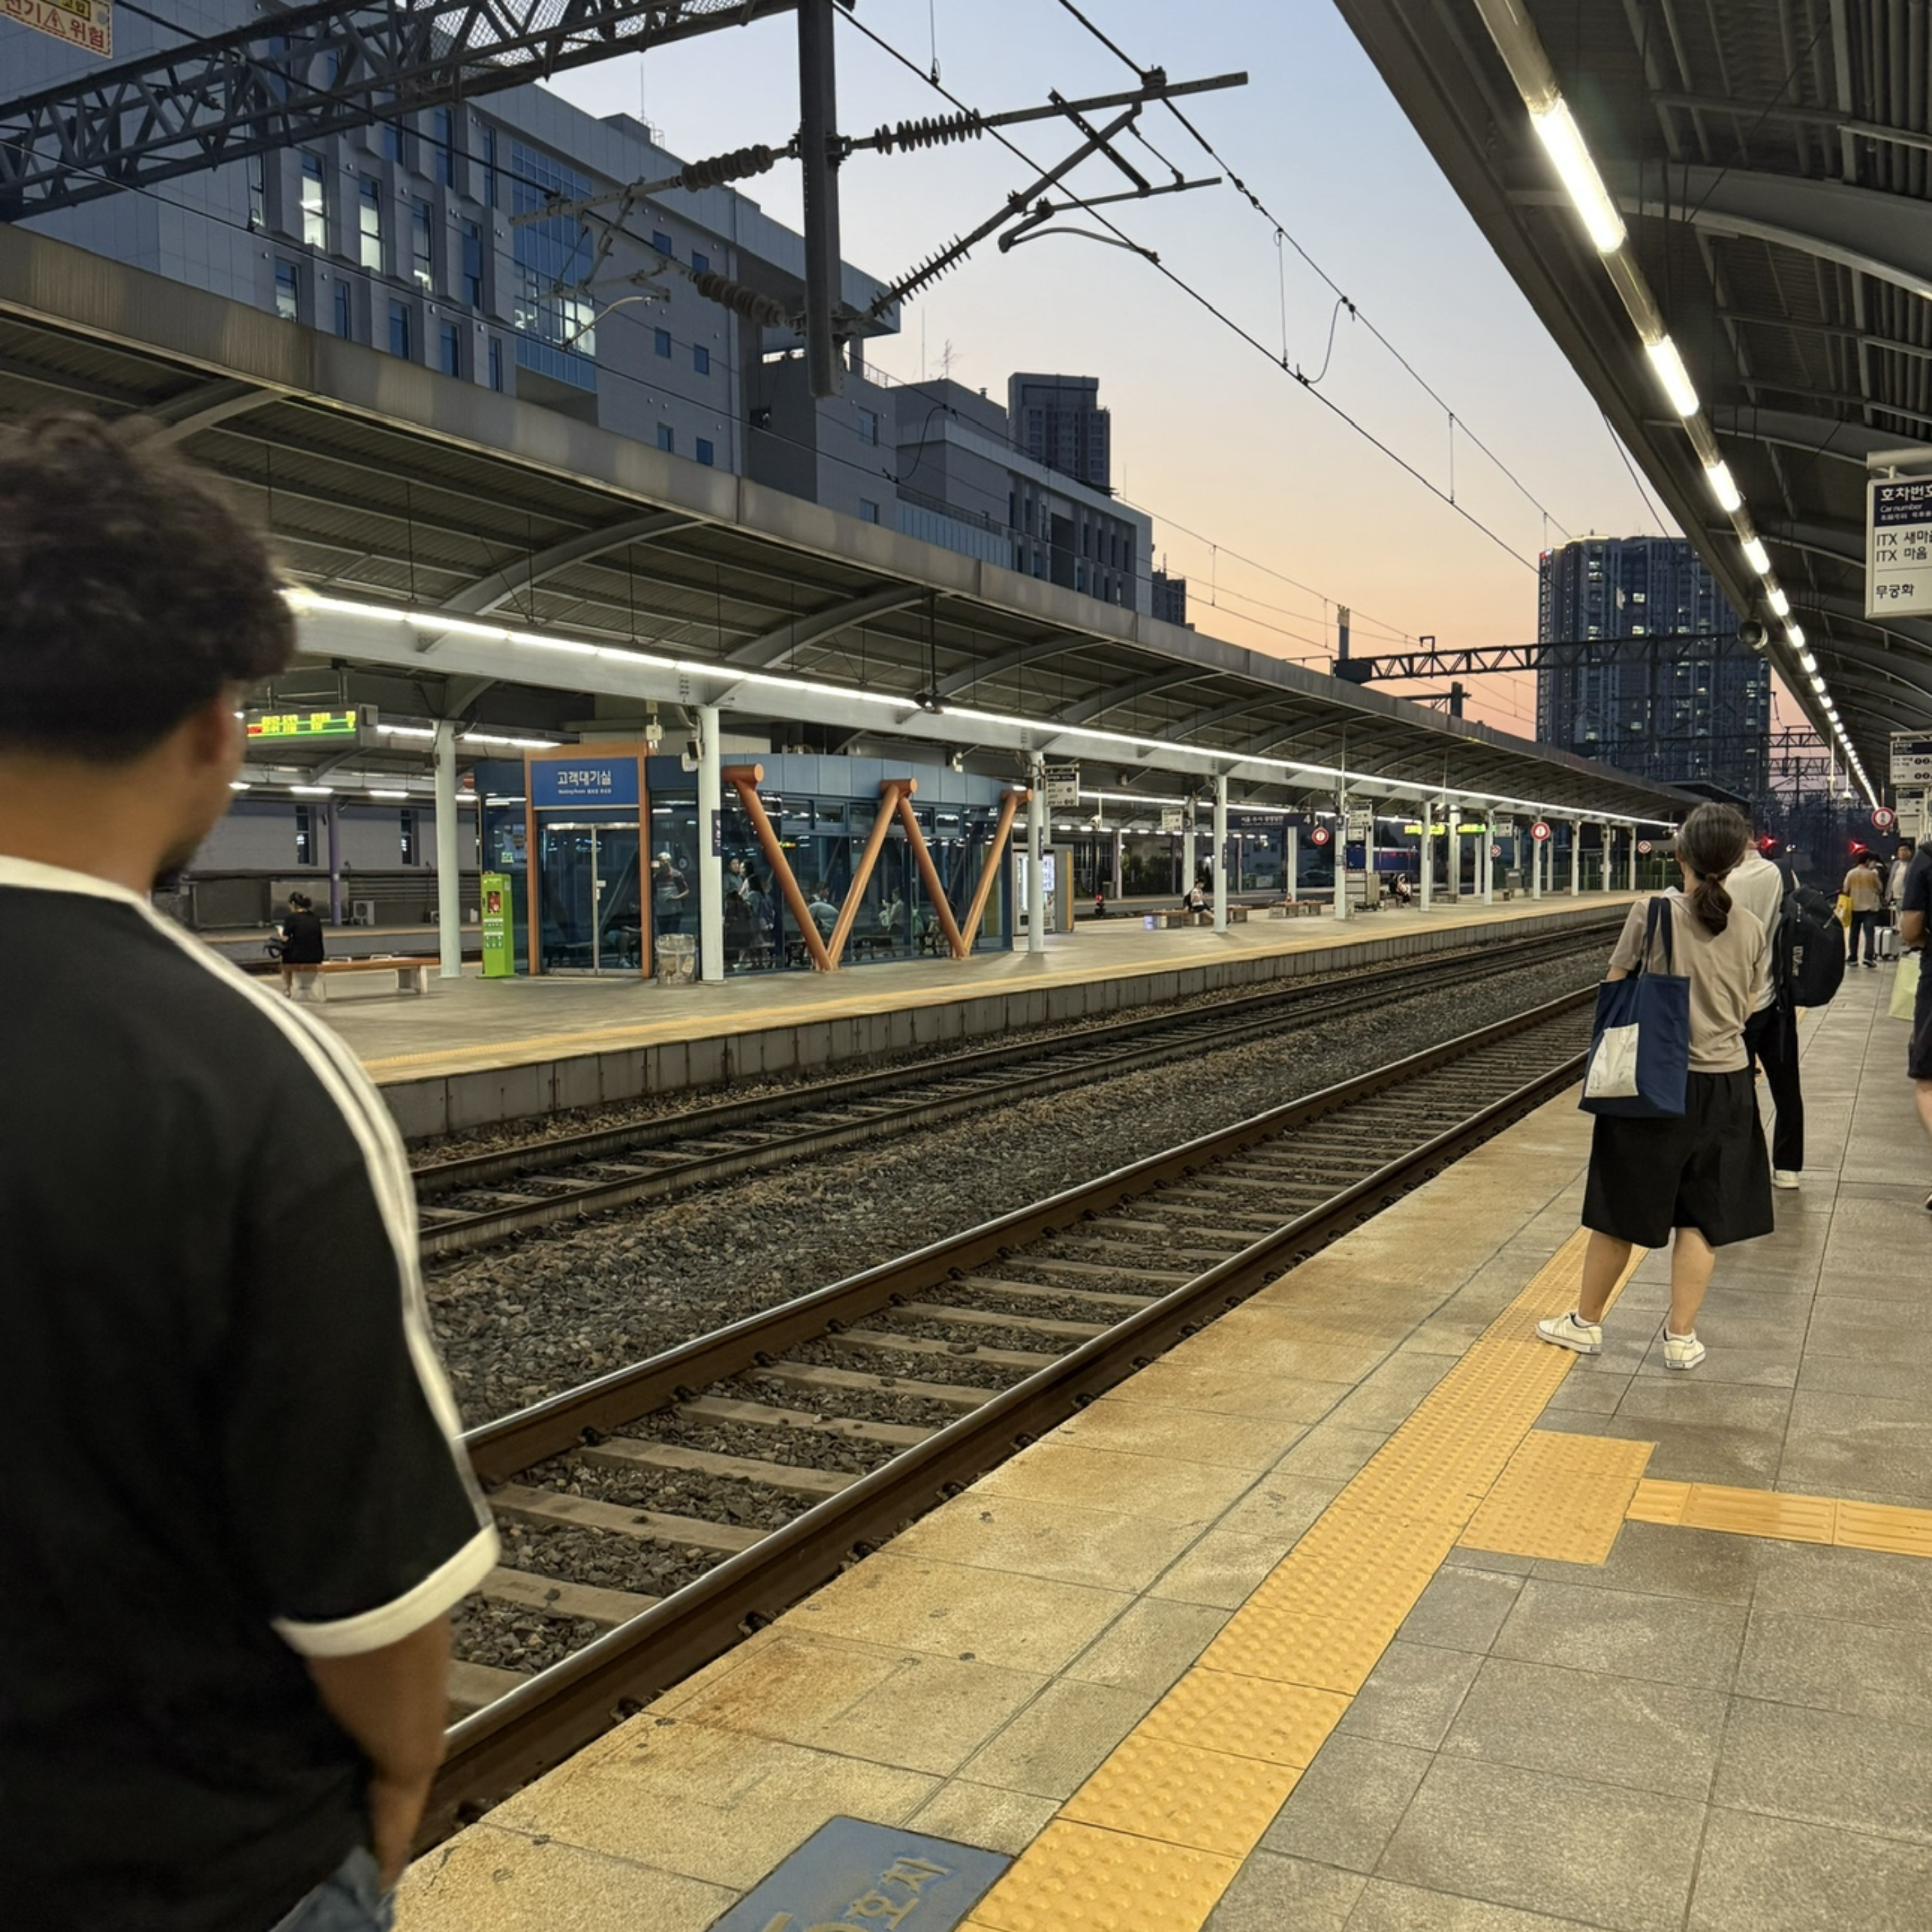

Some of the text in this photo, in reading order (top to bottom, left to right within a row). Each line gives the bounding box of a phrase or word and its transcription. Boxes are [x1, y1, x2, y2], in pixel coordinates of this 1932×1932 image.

[70, 18, 104, 48] 위험
[1877, 530, 1932, 547] ITX 새마
[1877, 546, 1927, 562] ITX 마음
[1876, 583, 1915, 599] 무궁화
[558, 770, 611, 786] 고객대기실
